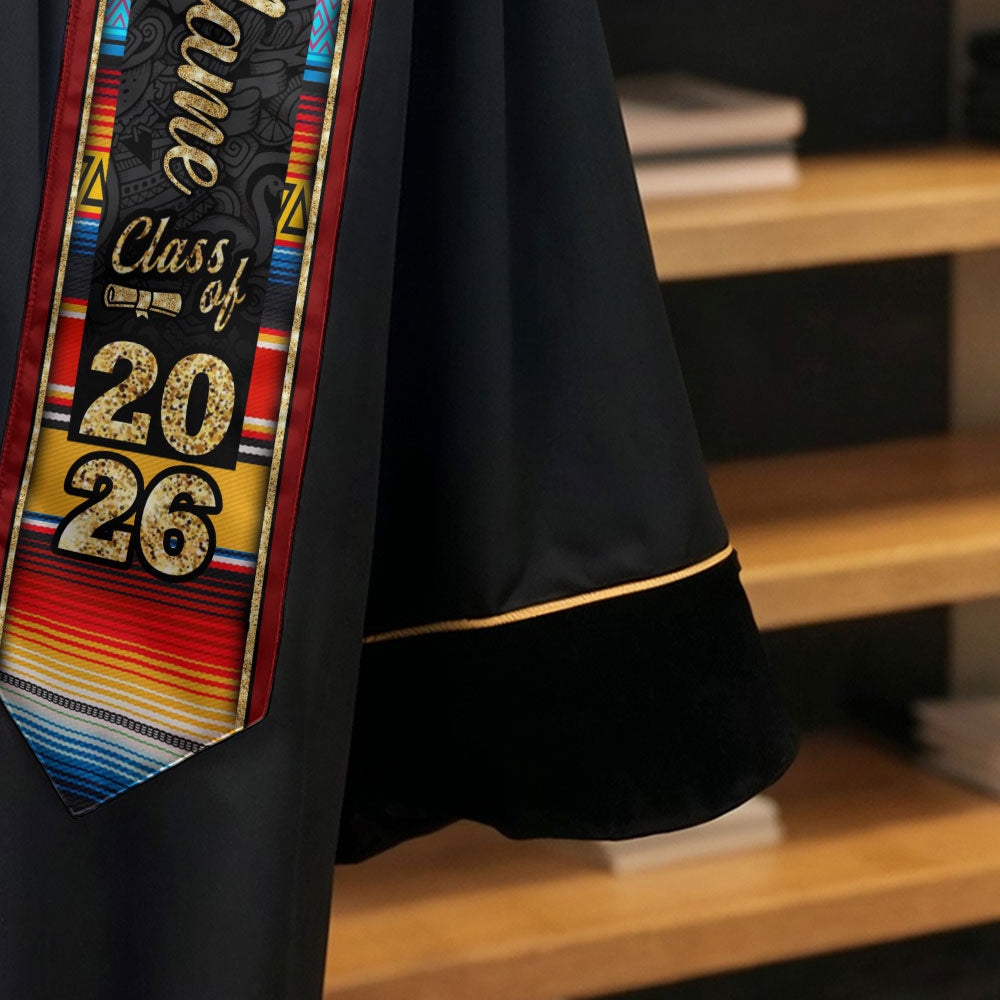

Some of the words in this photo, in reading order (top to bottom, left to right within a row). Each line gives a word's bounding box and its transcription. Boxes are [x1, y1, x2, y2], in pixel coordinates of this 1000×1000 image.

[111, 215, 229, 275] Class
[199, 258, 247, 332] of
[78, 340, 236, 456] 20
[57, 457, 217, 577] 26
